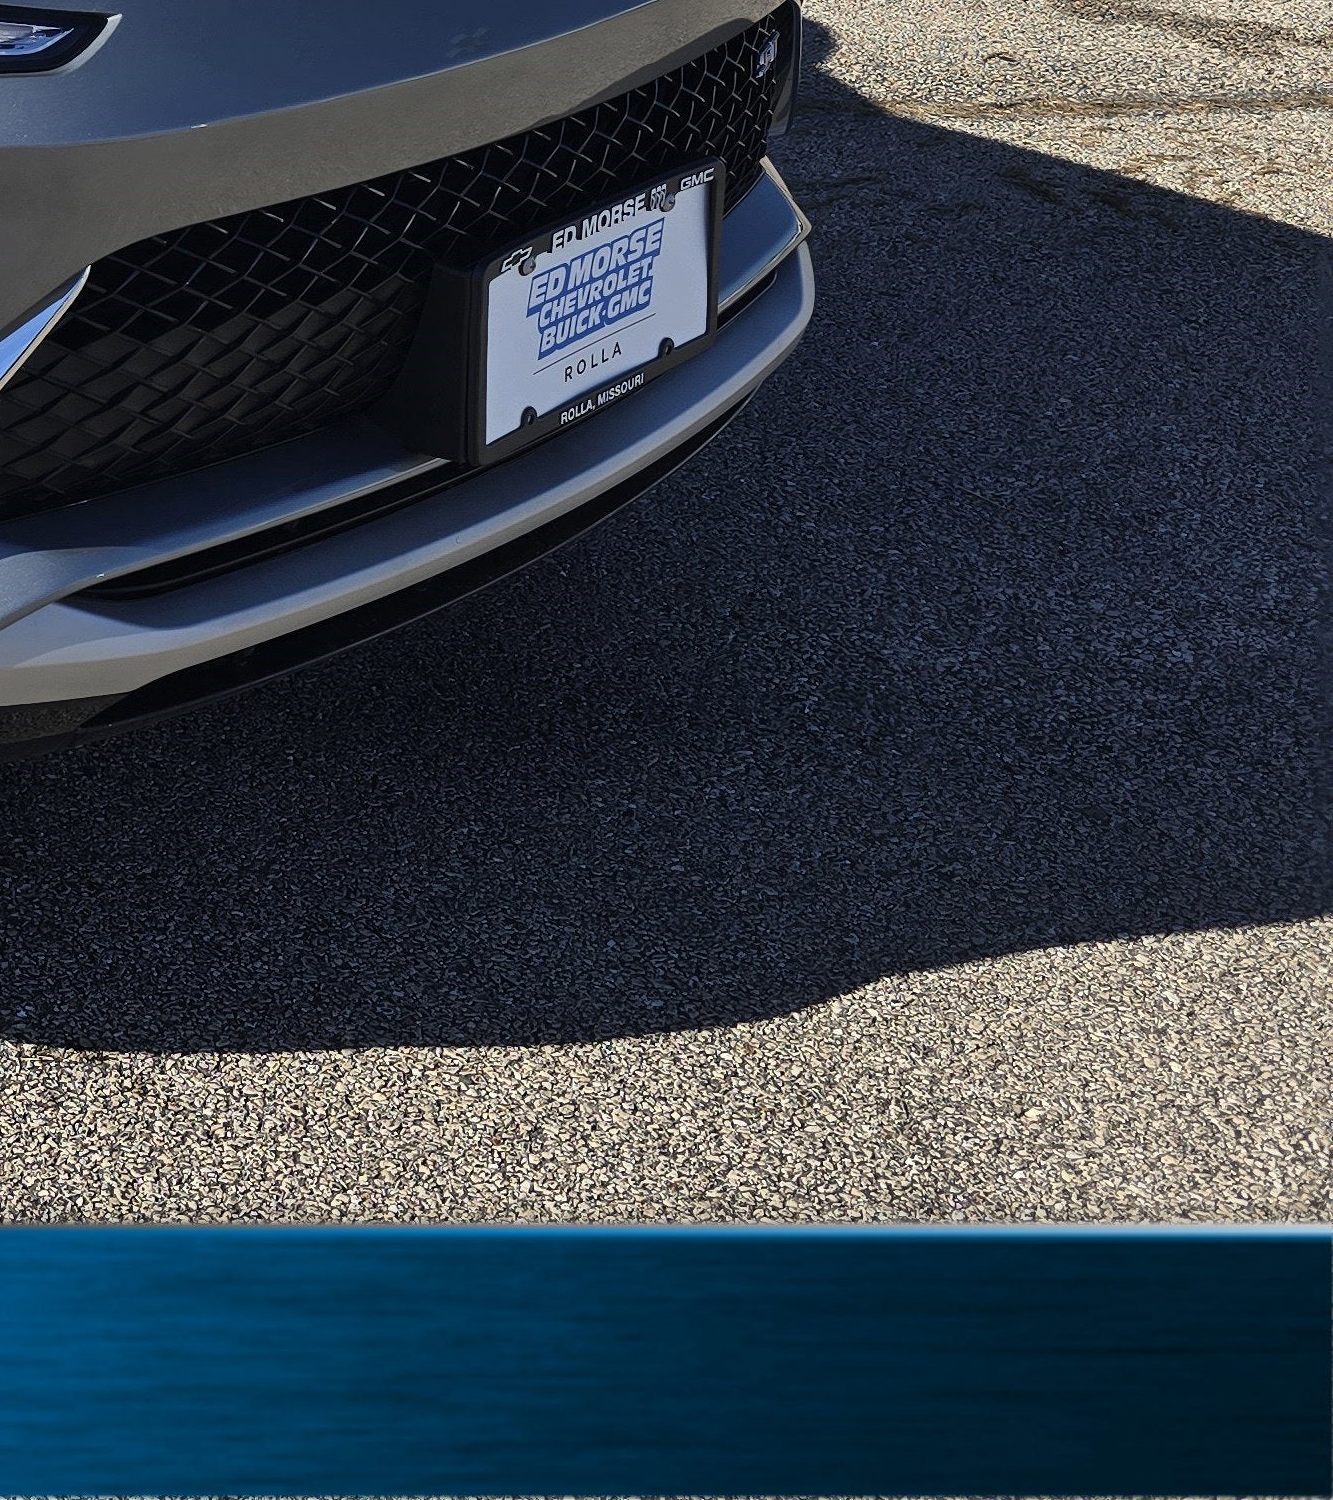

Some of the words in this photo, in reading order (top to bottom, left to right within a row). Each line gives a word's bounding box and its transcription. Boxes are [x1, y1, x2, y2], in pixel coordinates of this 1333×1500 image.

[551, 225, 577, 250] ED
[582, 192, 646, 238] MORSE
[680, 167, 715, 191] GMC
[528, 265, 567, 310] ED
[567, 219, 663, 291] MORSE
[564, 341, 622, 383] ROLLA
[560, 399, 596, 424] ROLLA,
[597, 372, 645, 406] MISSOURI
